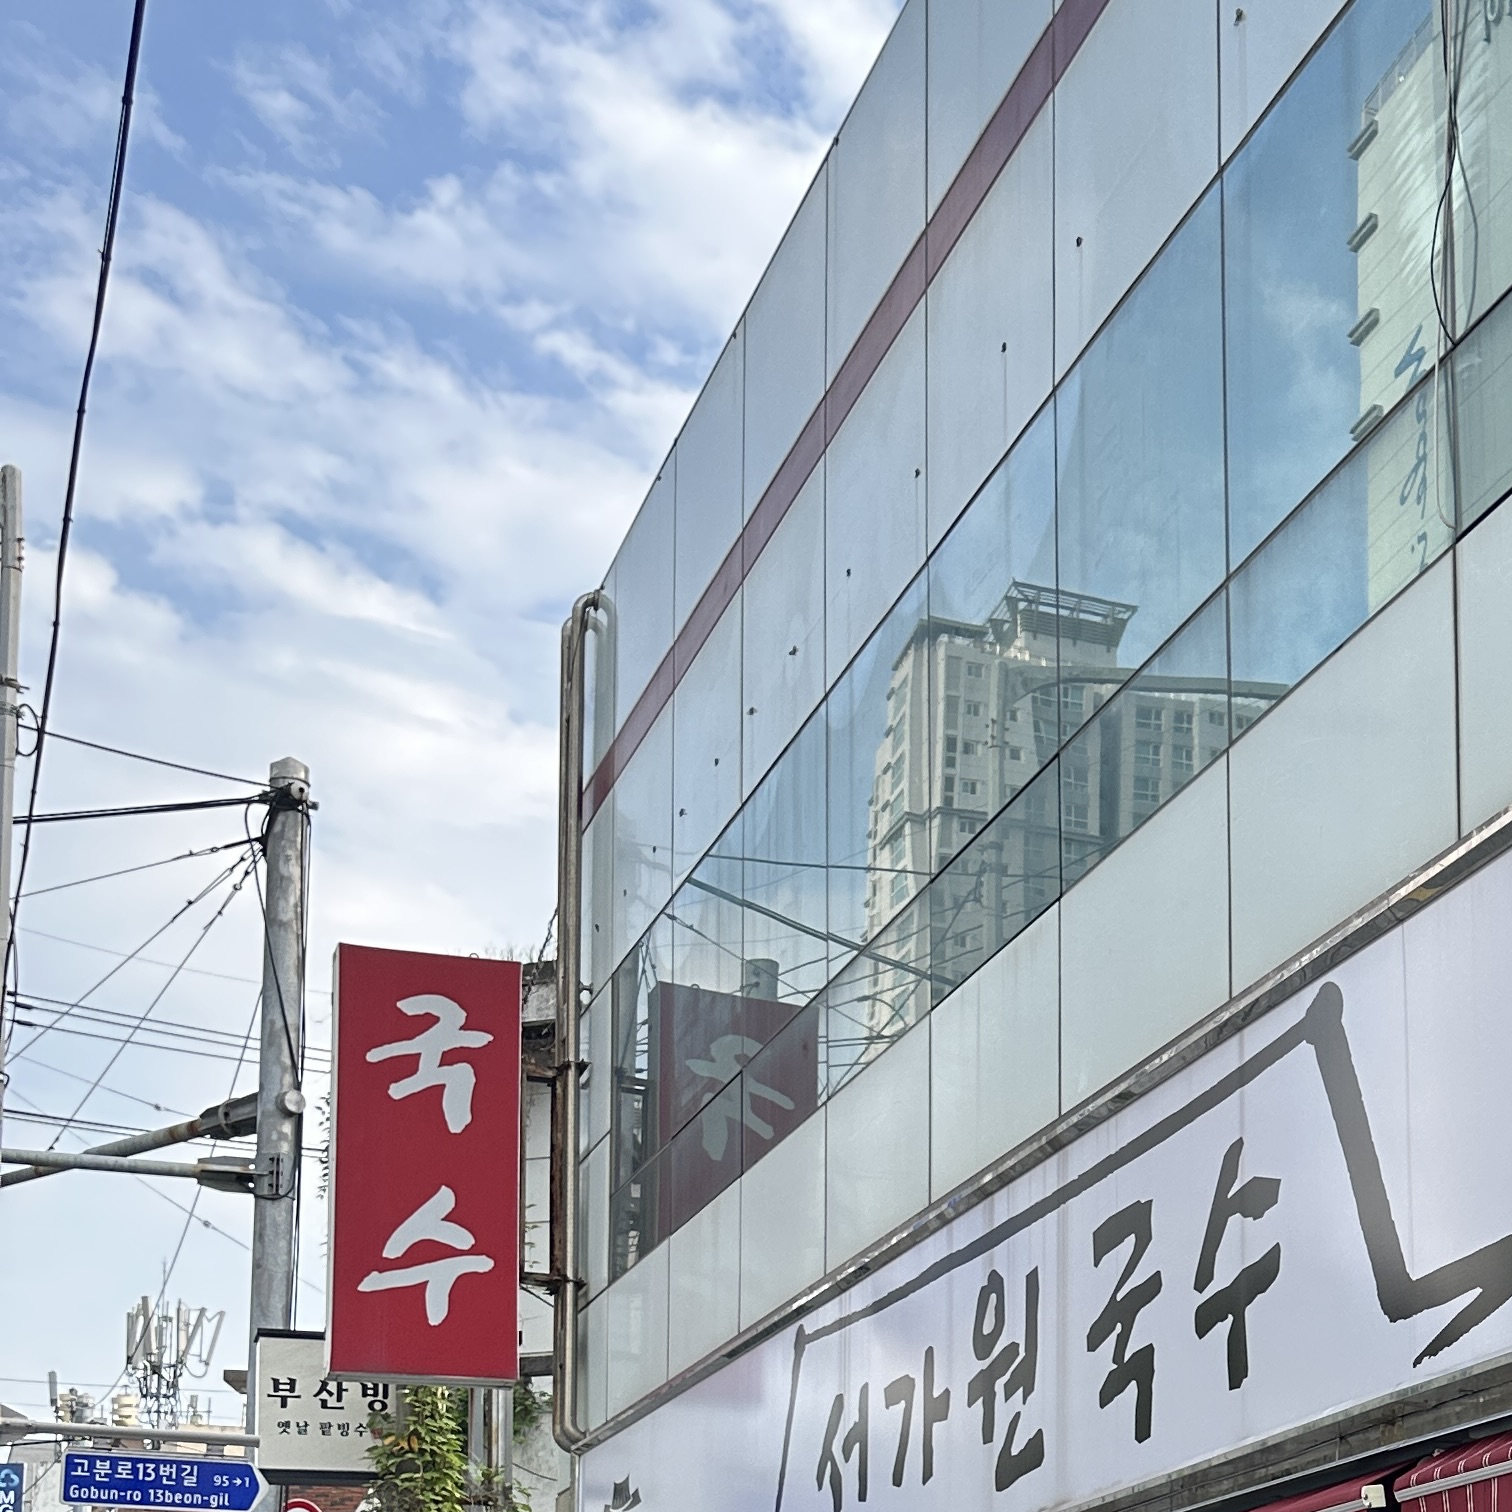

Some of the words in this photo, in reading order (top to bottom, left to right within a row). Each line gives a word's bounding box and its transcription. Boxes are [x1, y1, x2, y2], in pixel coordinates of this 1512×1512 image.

[358, 994, 495, 1326] 국수
[1087, 1137, 1282, 1444] 국수
[277, 1420, 309, 1435] 옛날
[70, 1458, 198, 1487] 고분로13번길
[69, 1484, 142, 1502] Gobun-ro
[149, 1488, 230, 1508] 13beon-gil
